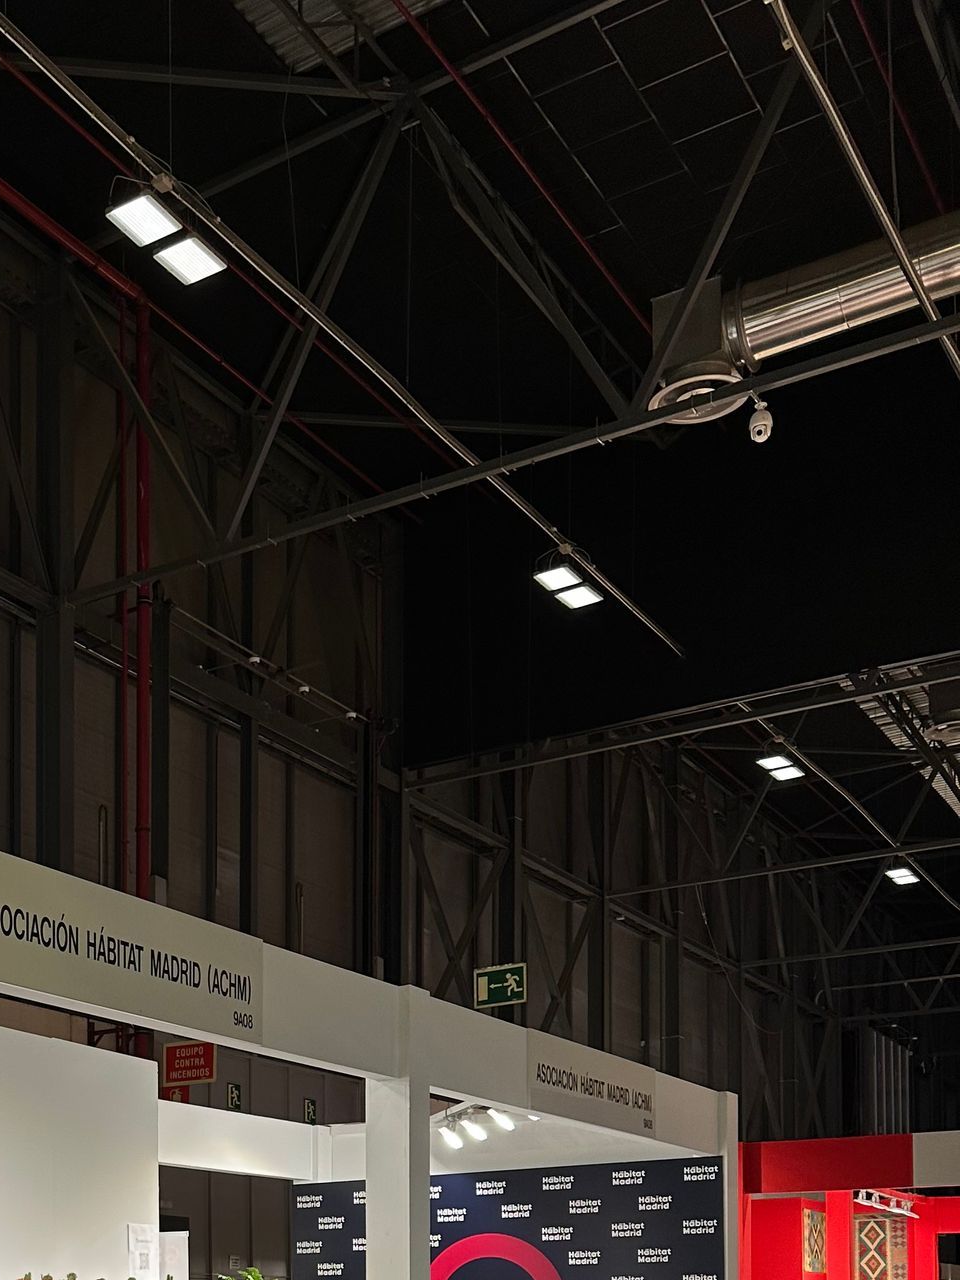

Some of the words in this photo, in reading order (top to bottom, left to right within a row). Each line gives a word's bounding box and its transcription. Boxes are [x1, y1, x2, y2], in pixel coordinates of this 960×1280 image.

[87, 926, 143, 972] HÁBITAT
[150, 949, 201, 988] MADRID
[207, 964, 252, 1005] (ACHM)
[232, 1011, 253, 1029] 9A08
[176, 1046, 204, 1057] EQUIPO
[175, 1058, 205, 1068] CONTRA
[170, 1068, 210, 1079] INCENDIOS
[536, 1062, 578, 1092] ASOCIACIÓN
[580, 1072, 605, 1099] HÁBITAT
[607, 1083, 629, 1106] MADRID
[632, 1088, 653, 1113] (ACHM)
[613, 1176, 642, 1185] Madrid
[684, 1173, 716, 1181] Madrid
[476, 1186, 503, 1195] Madrid
[543, 1182, 571, 1190] Madrid
[569, 1205, 598, 1213] Madrid
[639, 1202, 669, 1210] Madrid
[437, 1213, 464, 1222] Madrid
[502, 1209, 529, 1218] Madrid
[612, 1229, 641, 1237] Madrid
[683, 1226, 714, 1234] Madrid
[542, 1232, 570, 1241] Madrid
[569, 1257, 598, 1265] Madrid
